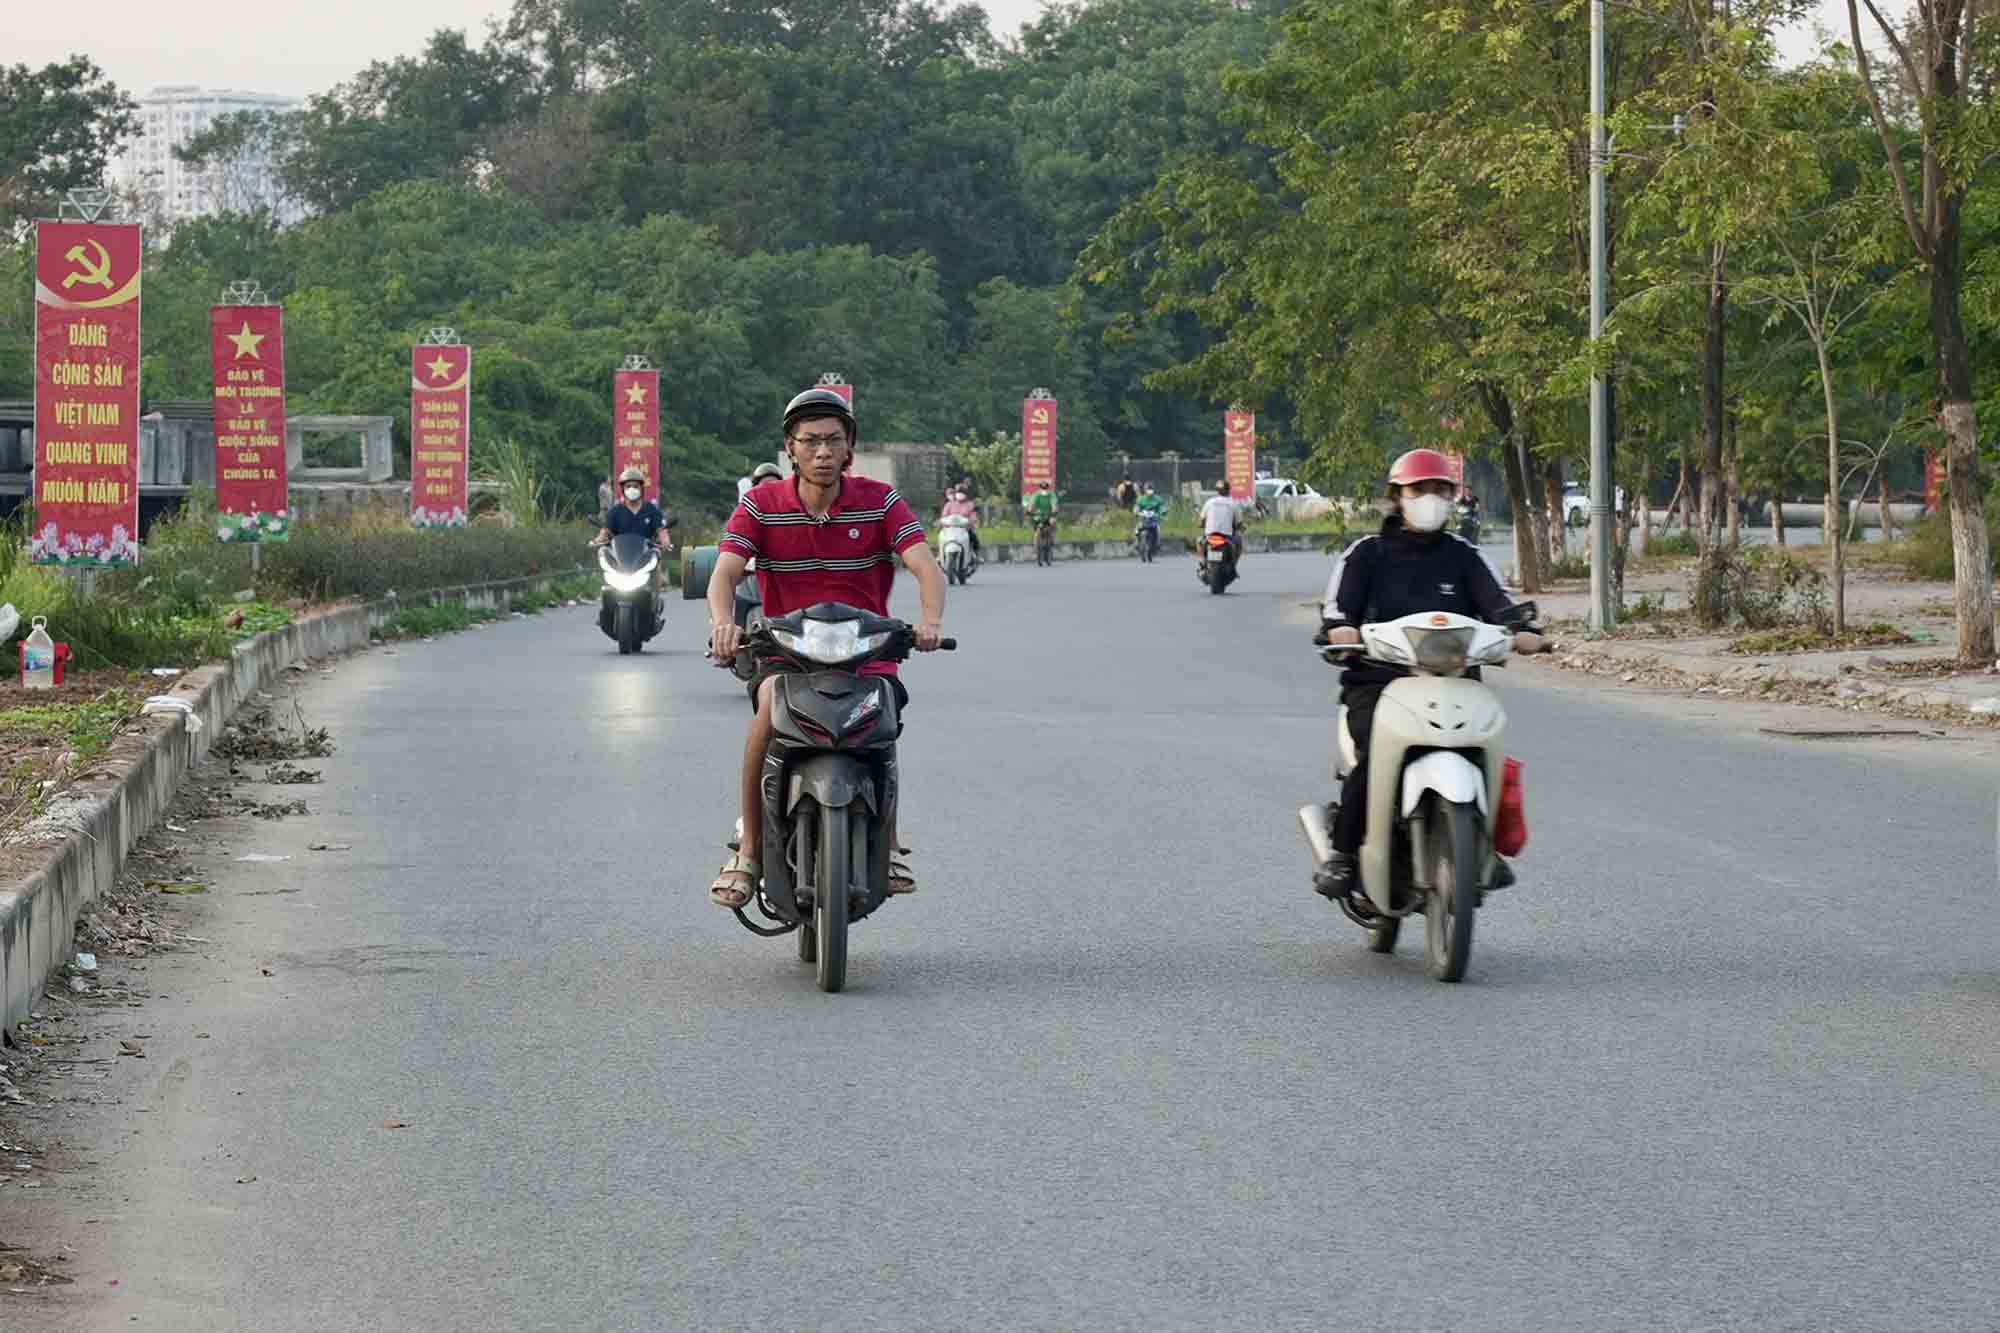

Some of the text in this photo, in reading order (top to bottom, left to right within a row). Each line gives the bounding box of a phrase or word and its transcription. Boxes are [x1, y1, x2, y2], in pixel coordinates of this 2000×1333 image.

[69, 318, 107, 346] ĐẢNG
[53, 358, 122, 390] CỘNG SẢN
[56, 398, 119, 429] VIỆT NAM
[46, 442, 128, 466] QUANG VINH
[43, 477, 84, 503] MUÔN
[88, 477, 119, 504] NĂM
